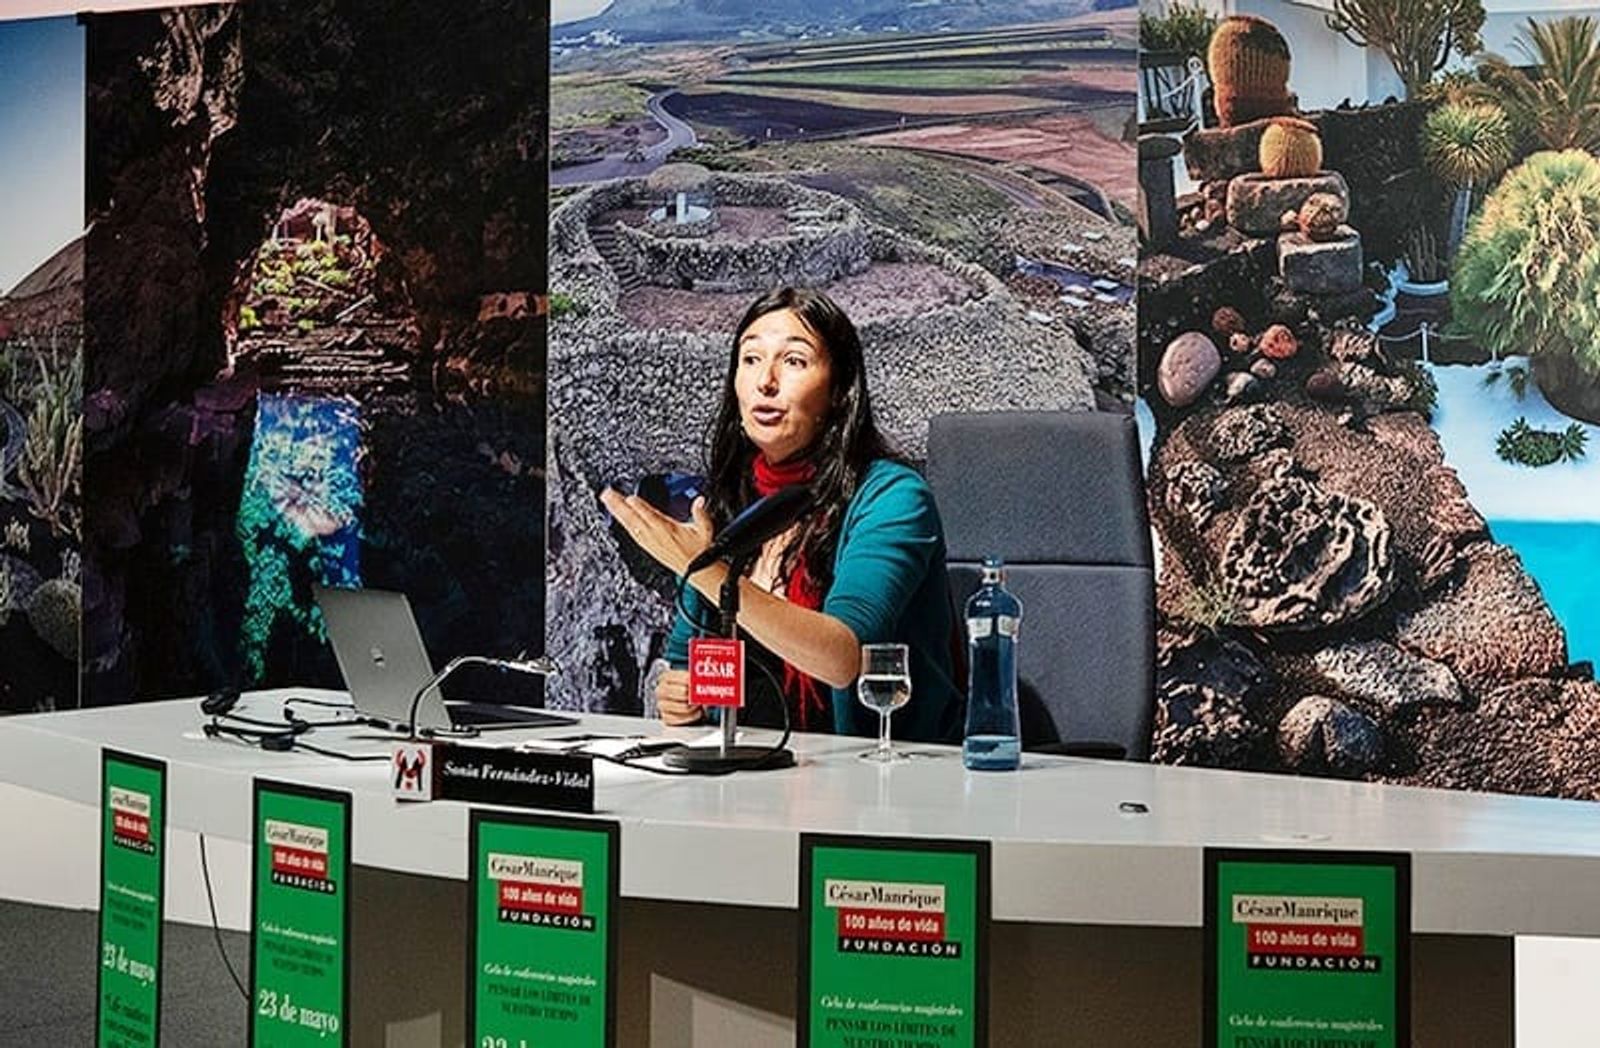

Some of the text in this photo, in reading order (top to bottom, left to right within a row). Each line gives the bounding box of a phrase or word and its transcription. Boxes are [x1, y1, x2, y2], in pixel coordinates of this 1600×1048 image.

[695, 656, 735, 678] CÉSAR
[444, 761, 479, 778] Sonia
[845, 914, 939, 933] 100 años de vida
[1255, 930, 1357, 947] 100 años de vida
[259, 989, 339, 1037] 23 de mayo
